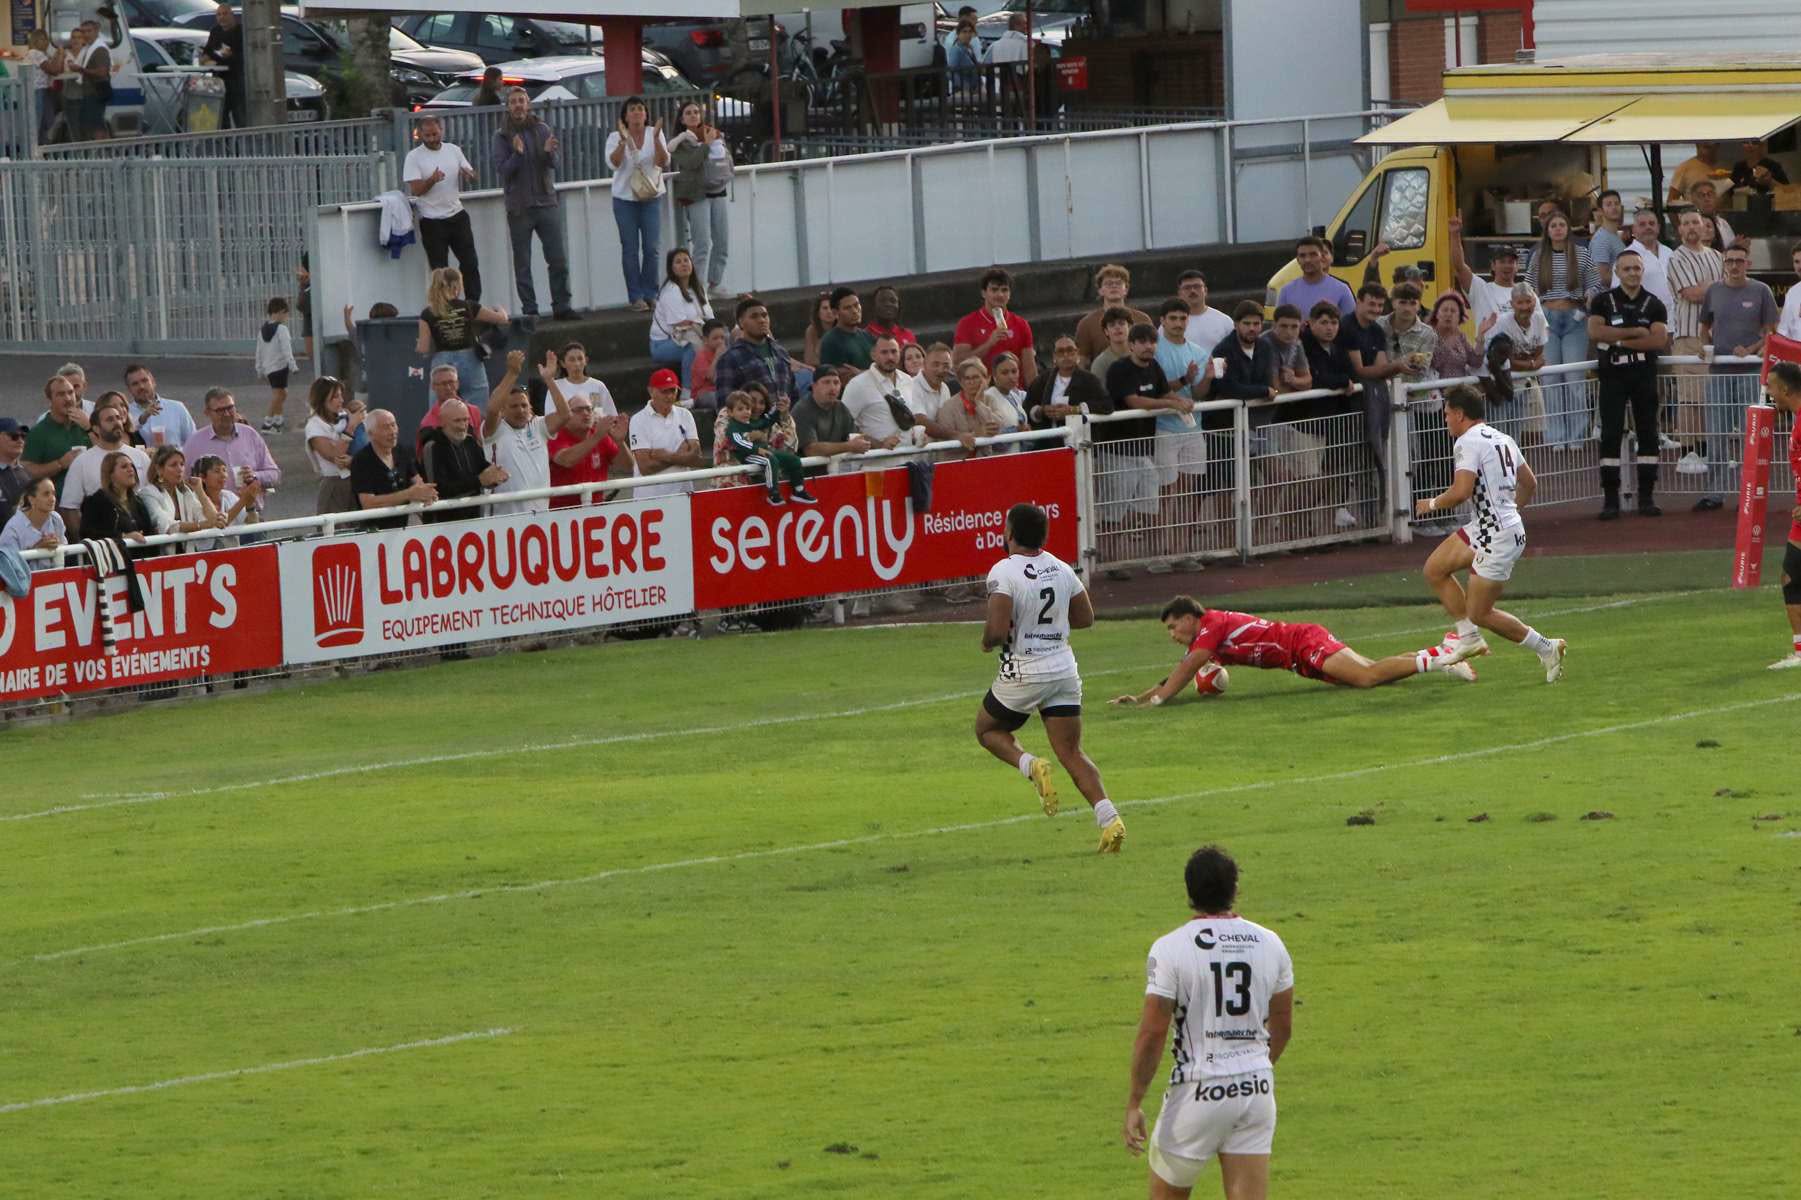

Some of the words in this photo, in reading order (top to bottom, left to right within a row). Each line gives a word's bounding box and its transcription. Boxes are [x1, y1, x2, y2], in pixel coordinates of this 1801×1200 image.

[1494, 443, 1516, 478] 14
[709, 495, 915, 581] serenly
[923, 509, 1002, 535] Résidence
[975, 531, 985, 550] à
[987, 530, 1005, 549] Da
[377, 508, 667, 606] LABRUQUERE
[34, 559, 238, 653] EVENT'S
[382, 608, 484, 642] EQUIPEMENT
[490, 595, 586, 624] TECHNIQUE
[592, 585, 667, 612] HÔTELIER
[1037, 586, 1056, 625] 2
[45, 662, 68, 687] DE
[73, 659, 107, 684] VOS
[111, 644, 211, 679] ÉVÉNEMENTS
[1218, 933, 1261, 943] CHEVAL
[1209, 961, 1252, 1018] 13
[1195, 1074, 1270, 1102] koesio
